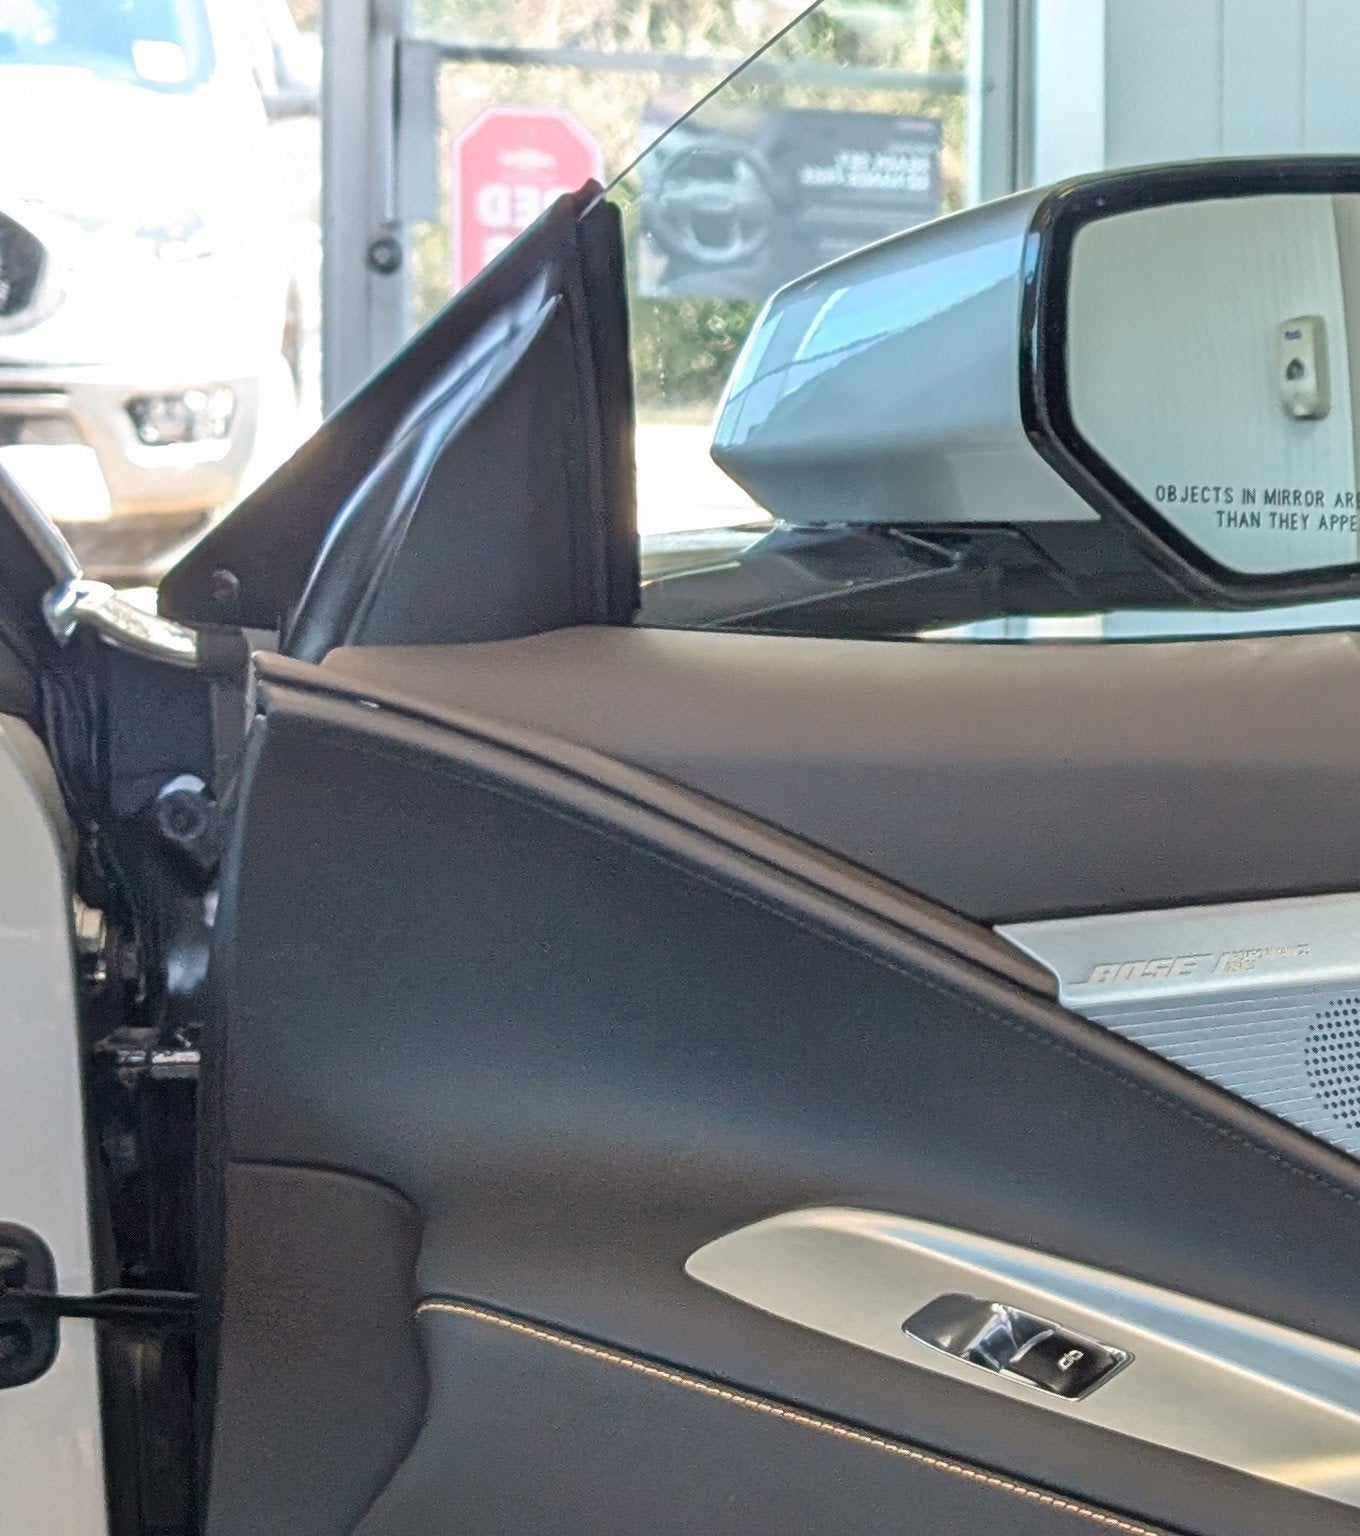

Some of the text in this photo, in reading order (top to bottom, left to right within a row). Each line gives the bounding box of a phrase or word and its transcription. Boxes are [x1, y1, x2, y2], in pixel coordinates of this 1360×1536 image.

[1155, 485, 1234, 504] OBJECTS
[1241, 487, 1256, 505] IN
[1264, 488, 1325, 508] MIRROR
[1216, 510, 1261, 528] THAN
[1269, 511, 1310, 531] THEY
[1068, 953, 1213, 985] BOSE
